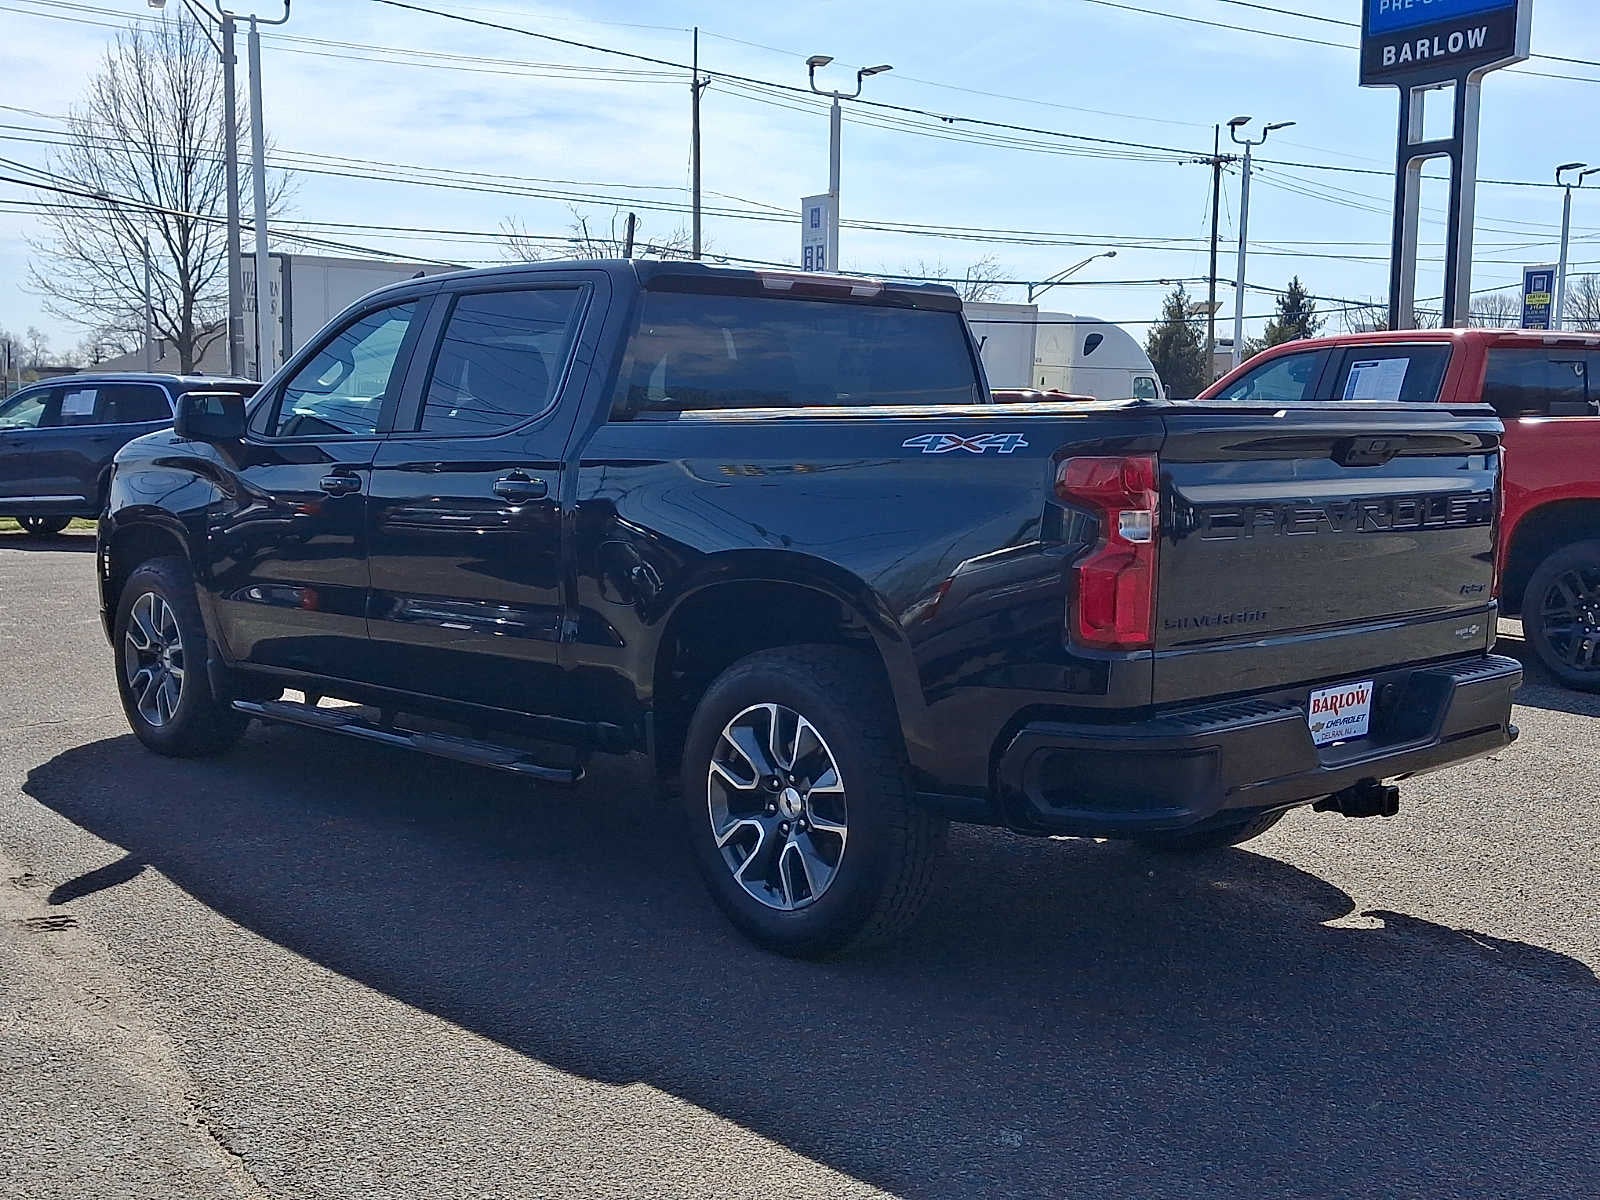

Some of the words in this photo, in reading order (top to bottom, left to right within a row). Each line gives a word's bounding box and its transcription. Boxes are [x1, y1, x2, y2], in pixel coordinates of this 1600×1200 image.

[1382, 26, 1488, 66] BARLOW
[1311, 689, 1370, 716] BARLOW
[1326, 714, 1367, 729] CHEVROLET
